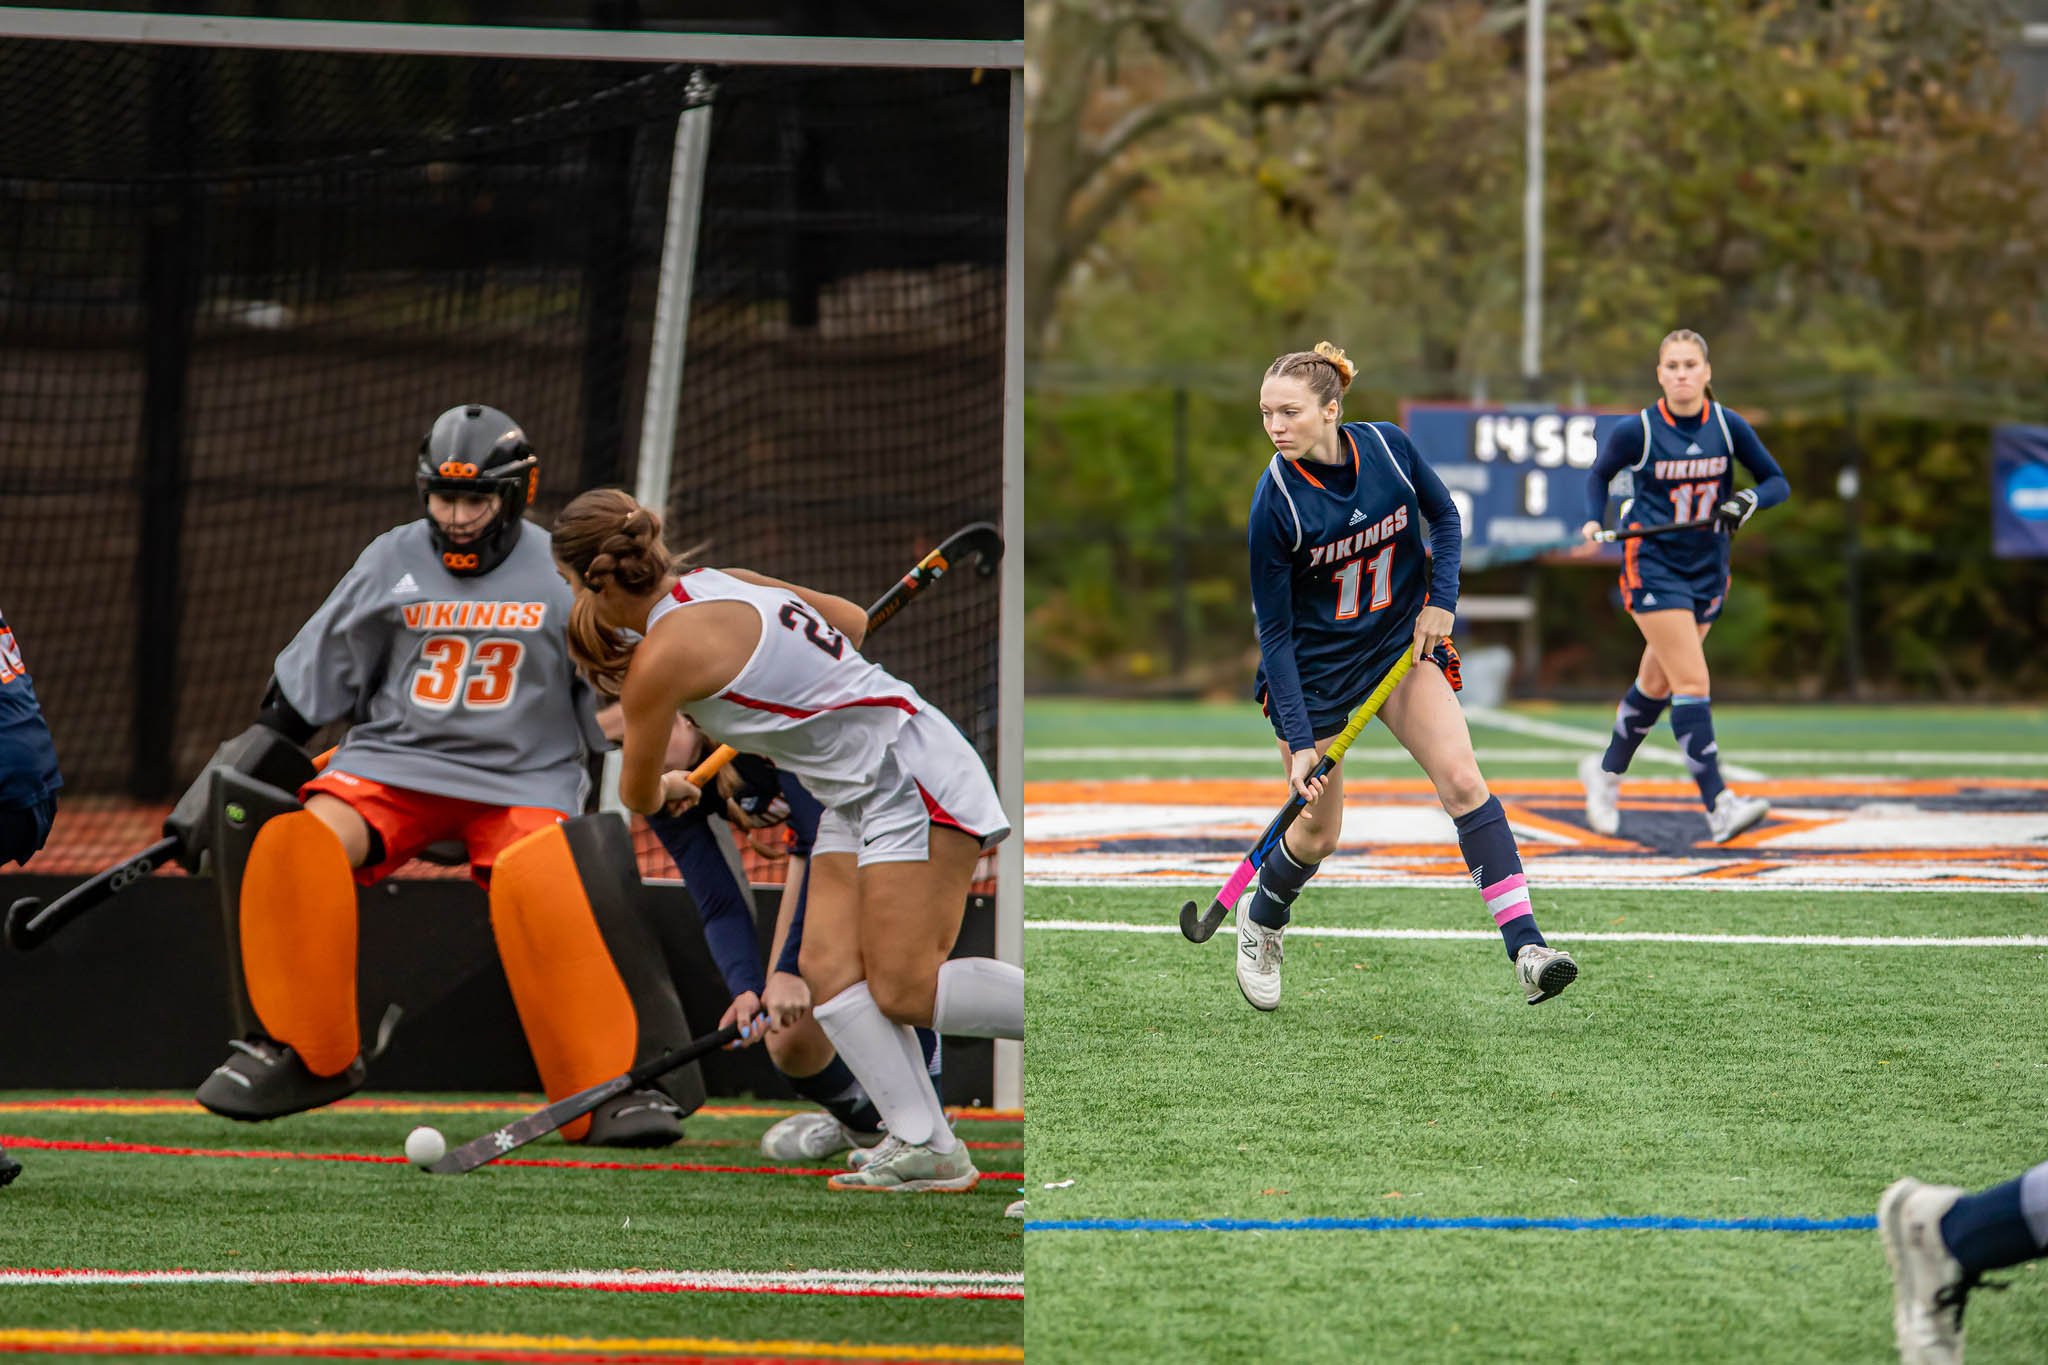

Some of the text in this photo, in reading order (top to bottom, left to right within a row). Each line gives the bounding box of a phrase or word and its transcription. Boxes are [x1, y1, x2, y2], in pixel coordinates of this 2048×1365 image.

[1669, 480, 1720, 525] 17
[1309, 504, 1408, 568] VIKINGS
[1332, 542, 1396, 620] 11
[401, 600, 546, 631] VIKINGS
[778, 600, 846, 661] 2
[410, 634, 526, 711] 33
